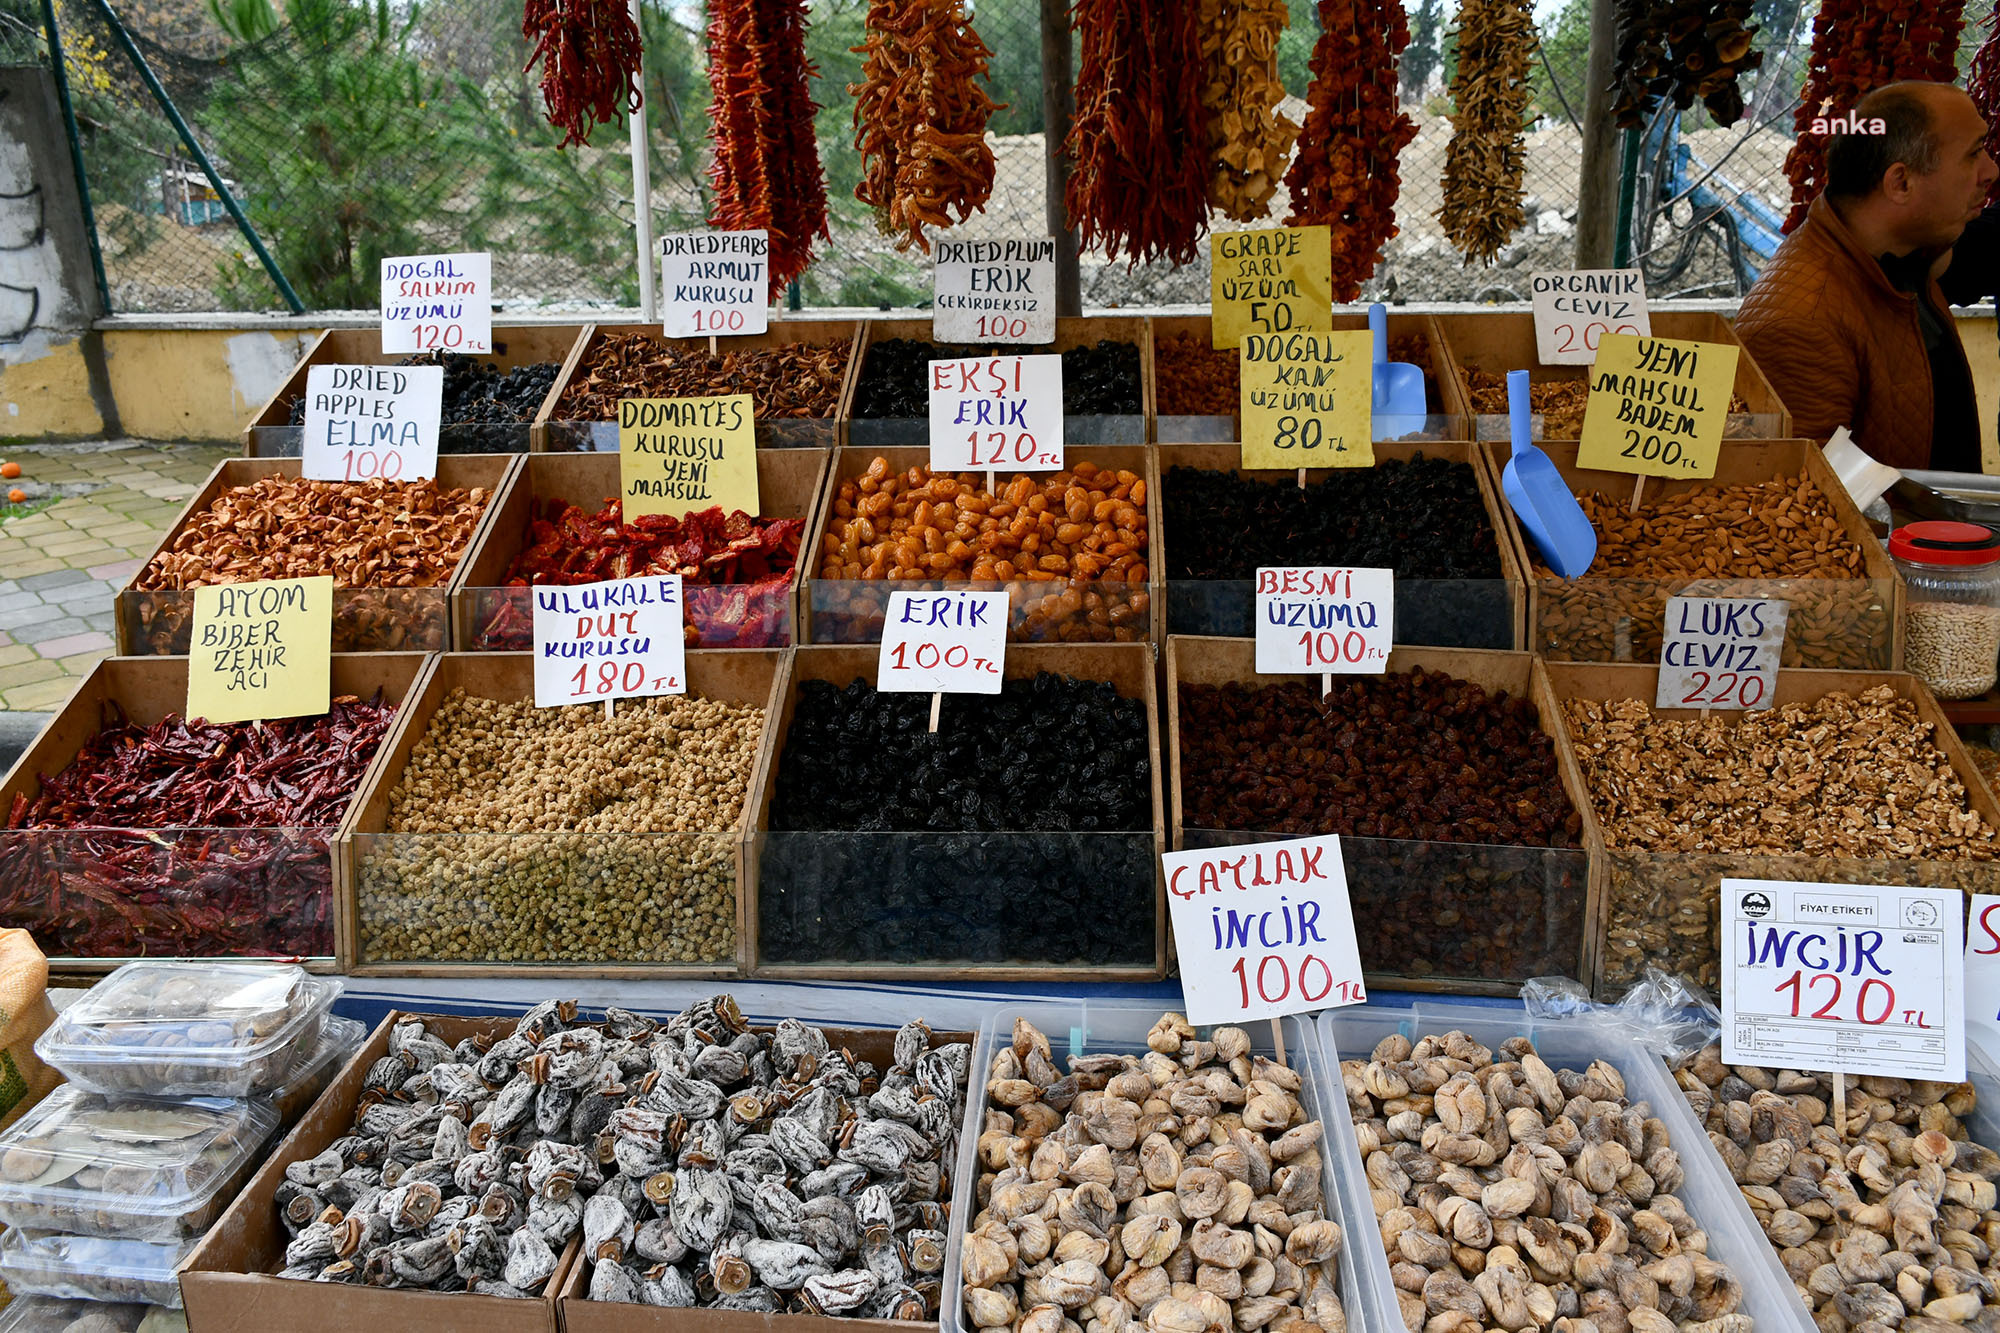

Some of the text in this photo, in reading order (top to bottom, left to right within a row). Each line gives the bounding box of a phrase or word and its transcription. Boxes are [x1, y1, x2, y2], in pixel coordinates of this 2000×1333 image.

[1221, 231, 1302, 258] GRAPE
[688, 261, 765, 282] ARMUT
[970, 263, 1033, 293] ERİK
[1237, 259, 1283, 278] SARI
[1533, 271, 1639, 295] ORGANİK
[400, 281, 476, 298] SALKIM
[673, 285, 754, 304] KURUSU
[1222, 278, 1301, 300] ÜZÜM
[386, 298, 464, 321] ÜZÜMÜ
[692, 309, 744, 332] 100
[1251, 302, 1293, 333] 50
[412, 324, 463, 349] 120
[976, 315, 1027, 338] 100
[1635, 339, 1700, 380] YENİ
[933, 357, 1024, 398] EKŞİ
[1273, 364, 1335, 387] KAN
[315, 394, 395, 419] APPLES
[1250, 388, 1336, 412] ÜZÜMÜ
[1591, 373, 1704, 412] MAHSUL
[622, 400, 742, 431] DOMATES
[953, 396, 1027, 429] ERİK
[1616, 398, 1698, 439] BADEM
[327, 418, 420, 446] ELMA
[634, 432, 724, 460] KURUSU
[1273, 416, 1322, 449] 80
[967, 431, 1037, 465] 120
[1620, 429, 1681, 466] 200
[341, 449, 403, 481] 100
[664, 459, 708, 483] YENİ
[628, 480, 712, 500] MAHSUL
[538, 580, 676, 614] ULUKALE
[1257, 569, 1353, 599] BESNİ
[214, 584, 308, 618] ATOM
[899, 592, 988, 629] ERİK
[200, 619, 282, 650] BİBER
[576, 610, 638, 639] DUT
[214, 645, 286, 673] ZEHİR
[545, 637, 651, 659] KURUSU
[891, 641, 969, 669] 100
[1298, 630, 1366, 667] 100
[1665, 636, 1762, 672] CEVİZ
[227, 670, 267, 691] ACI
[570, 661, 645, 697] 180
[1681, 671, 1764, 707] 220
[1170, 846, 1328, 900] ÇATLAK
[1212, 895, 1327, 950] İNCİR
[1800, 902, 1873, 915] FİYAT ETİKETİ
[1747, 921, 1893, 977] İNCİR
[1231, 953, 1333, 1009] 100
[1775, 970, 1896, 1025] 120
